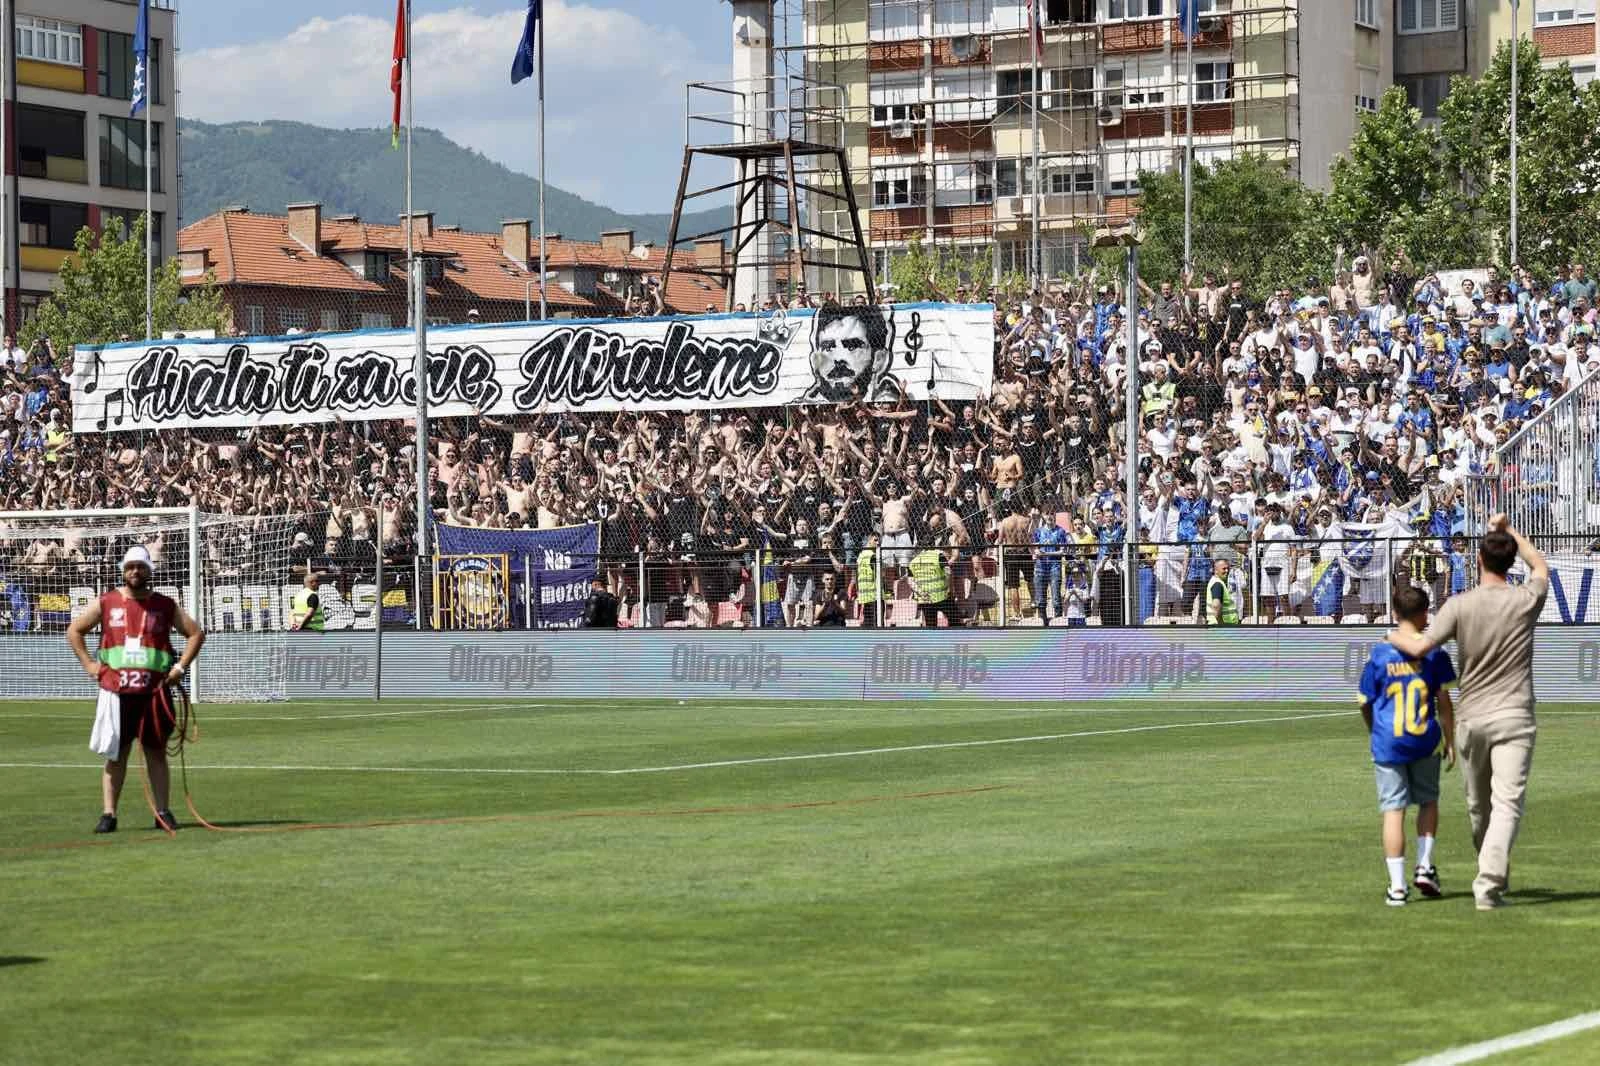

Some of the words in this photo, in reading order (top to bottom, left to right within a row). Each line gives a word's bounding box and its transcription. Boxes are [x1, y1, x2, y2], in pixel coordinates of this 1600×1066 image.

[127, 345, 278, 421] Hvala
[278, 343, 331, 414] ti
[328, 351, 400, 410] za
[514, 321, 783, 411] Miraleme
[450, 645, 552, 689] Olimpija
[673, 643, 781, 690] Olimpija
[872, 644, 989, 690] Olimpija
[1081, 643, 1206, 691] Olimpija
[1386, 679, 1428, 737] 10
